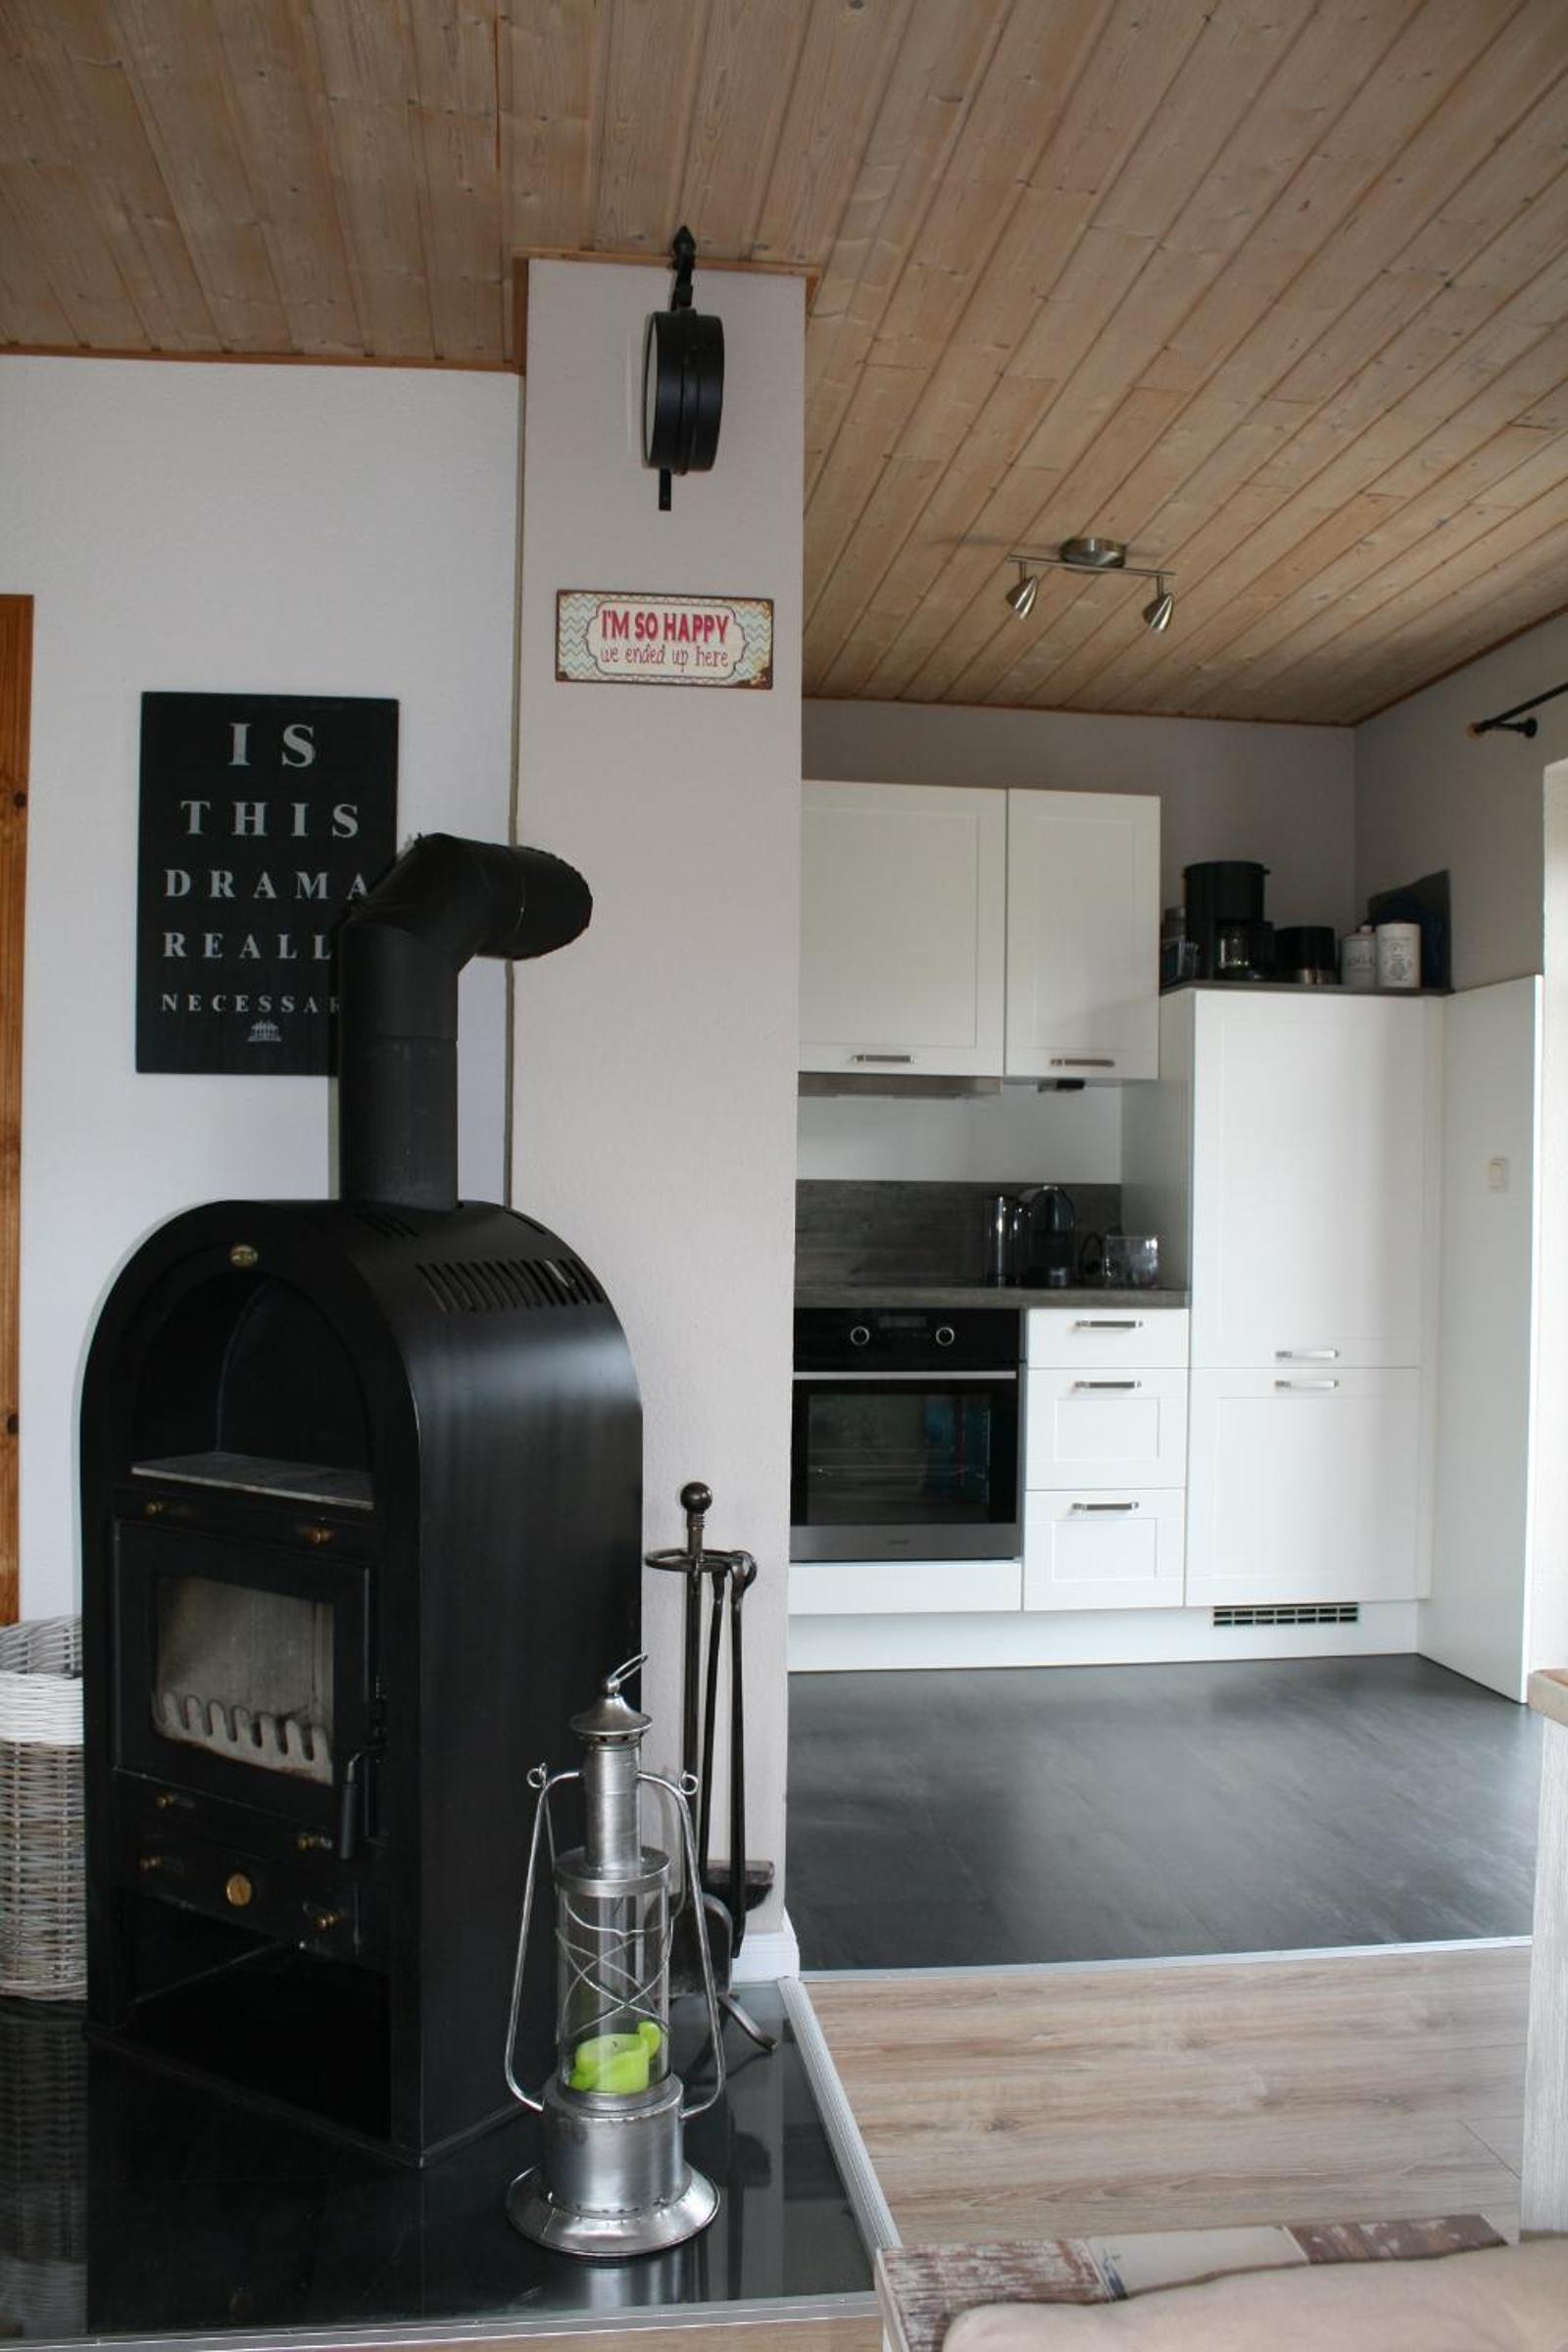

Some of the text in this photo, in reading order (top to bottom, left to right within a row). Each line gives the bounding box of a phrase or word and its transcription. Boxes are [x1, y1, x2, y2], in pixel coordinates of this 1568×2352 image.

[602, 610, 729, 644] I'M SO HAPPY
[601, 644, 728, 672] we ended up here
[228, 722, 316, 768] IS
[180, 801, 359, 838] THIS
[165, 869, 368, 900] DRAMA
[163, 932, 331, 960] REALL
[162, 994, 340, 1013] NECESSAR
